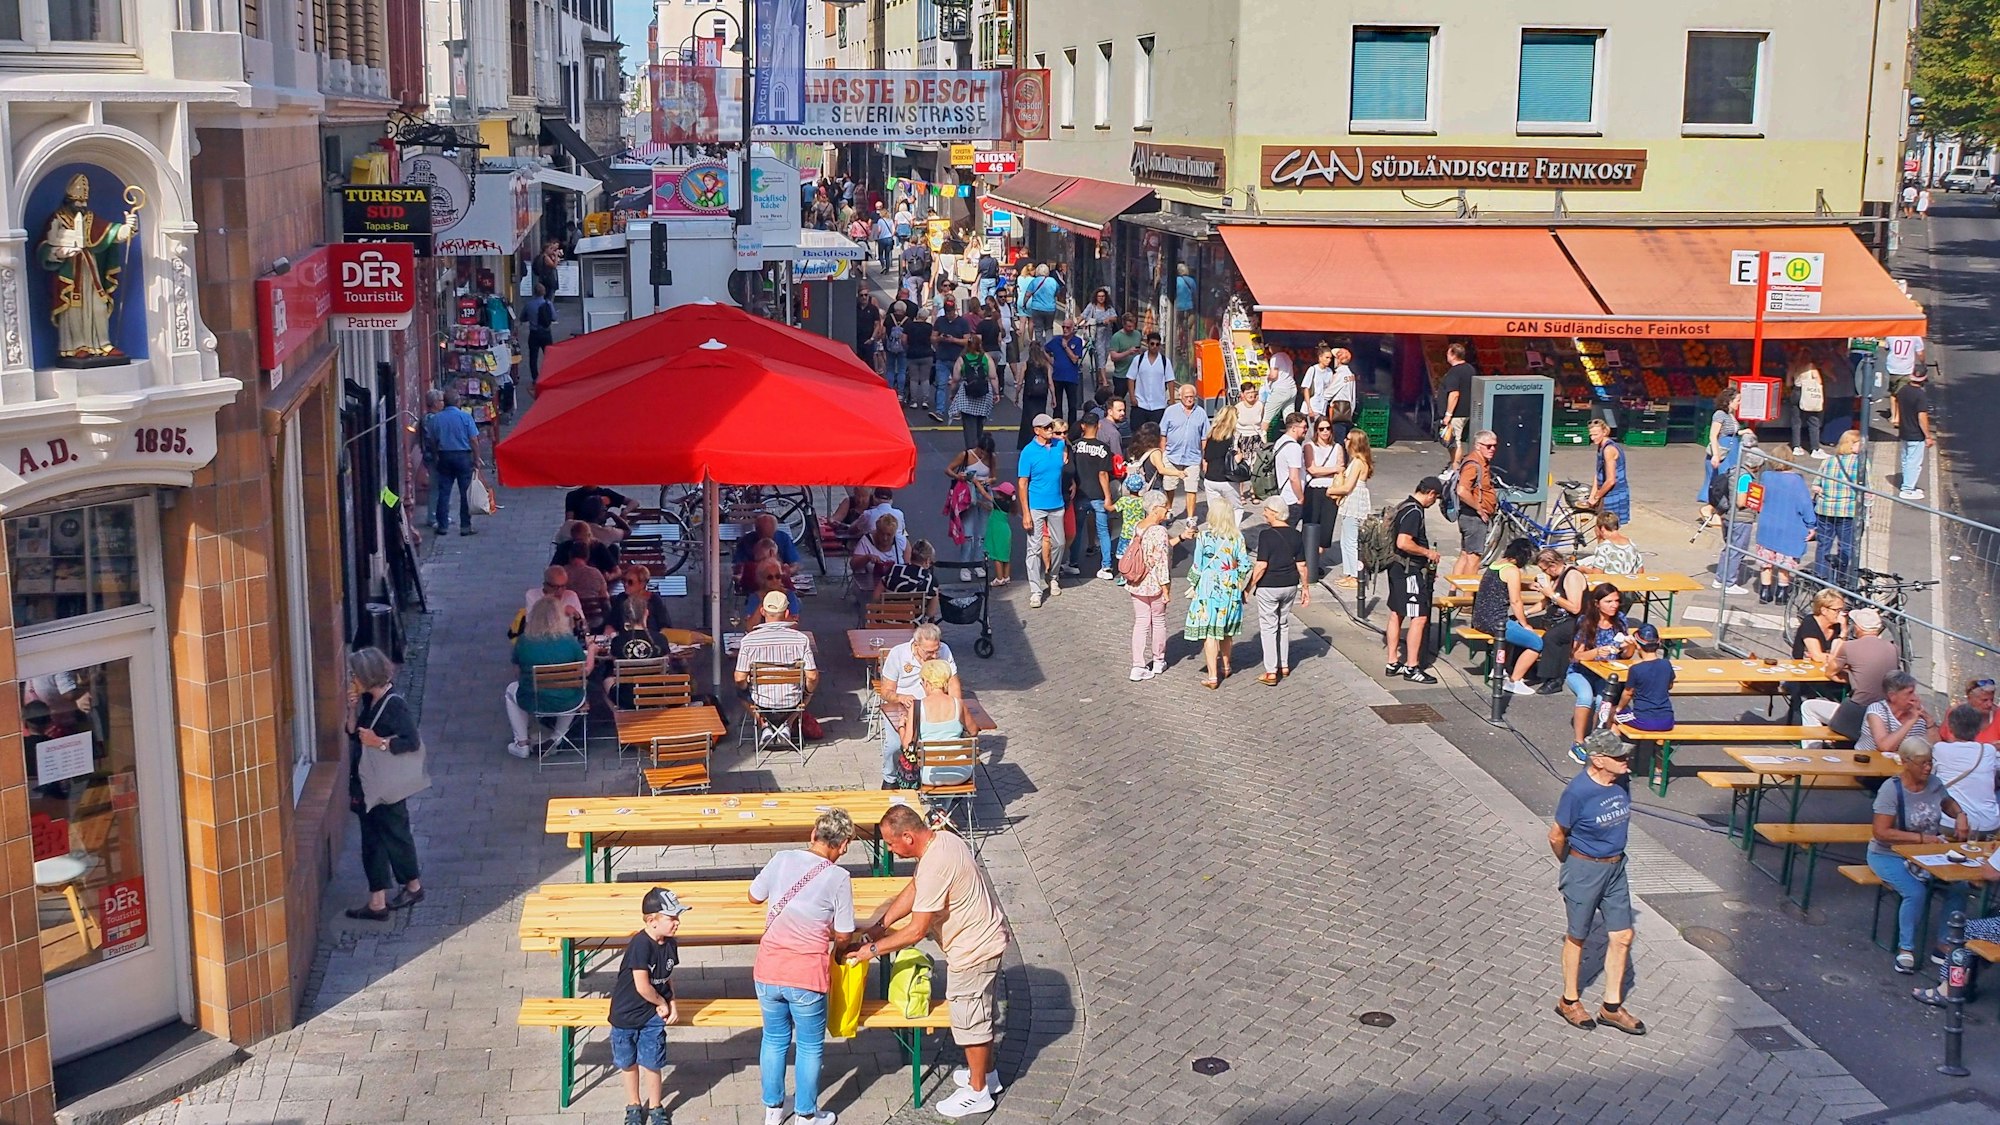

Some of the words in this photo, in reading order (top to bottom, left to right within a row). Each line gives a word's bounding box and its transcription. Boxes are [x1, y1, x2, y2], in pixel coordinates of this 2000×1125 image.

[758, 57, 770, 121] SEVERINALE
[904, 78, 987, 104] DESCH
[832, 105, 987, 123] SEVERINSTRASSE
[770, 125, 783, 136] 3.
[786, 125, 878, 136] Wochenende
[883, 125, 900, 136] im
[905, 124, 981, 138] September
[975, 153, 1015, 163] KIOSK
[988, 163, 1004, 172] 46
[1269, 147, 1364, 186] CAN
[1371, 154, 1530, 179] SÜDLÄNDISCHE
[1534, 157, 1636, 180] FEINKOST
[345, 189, 427, 203] TURISTA
[365, 222, 409, 231] Tapas-Bar
[803, 249, 858, 258] Backfisch
[342, 261, 403, 288] DER
[1738, 260, 1752, 282] E
[1792, 262, 1804, 277] H
[344, 291, 404, 303] Touristik
[348, 317, 398, 328] Partner
[1506, 321, 1538, 333] CAN
[1544, 321, 1643, 335] Südländische
[1648, 323, 1711, 335] Feinkost
[1893, 339, 1912, 357] 07
[1495, 383, 1543, 392] Chlodwigplatz
[19, 438, 78, 476] A.D.
[104, 890, 140, 915] DER
[106, 908, 141, 925] Touristik
[107, 941, 138, 957] Partner
